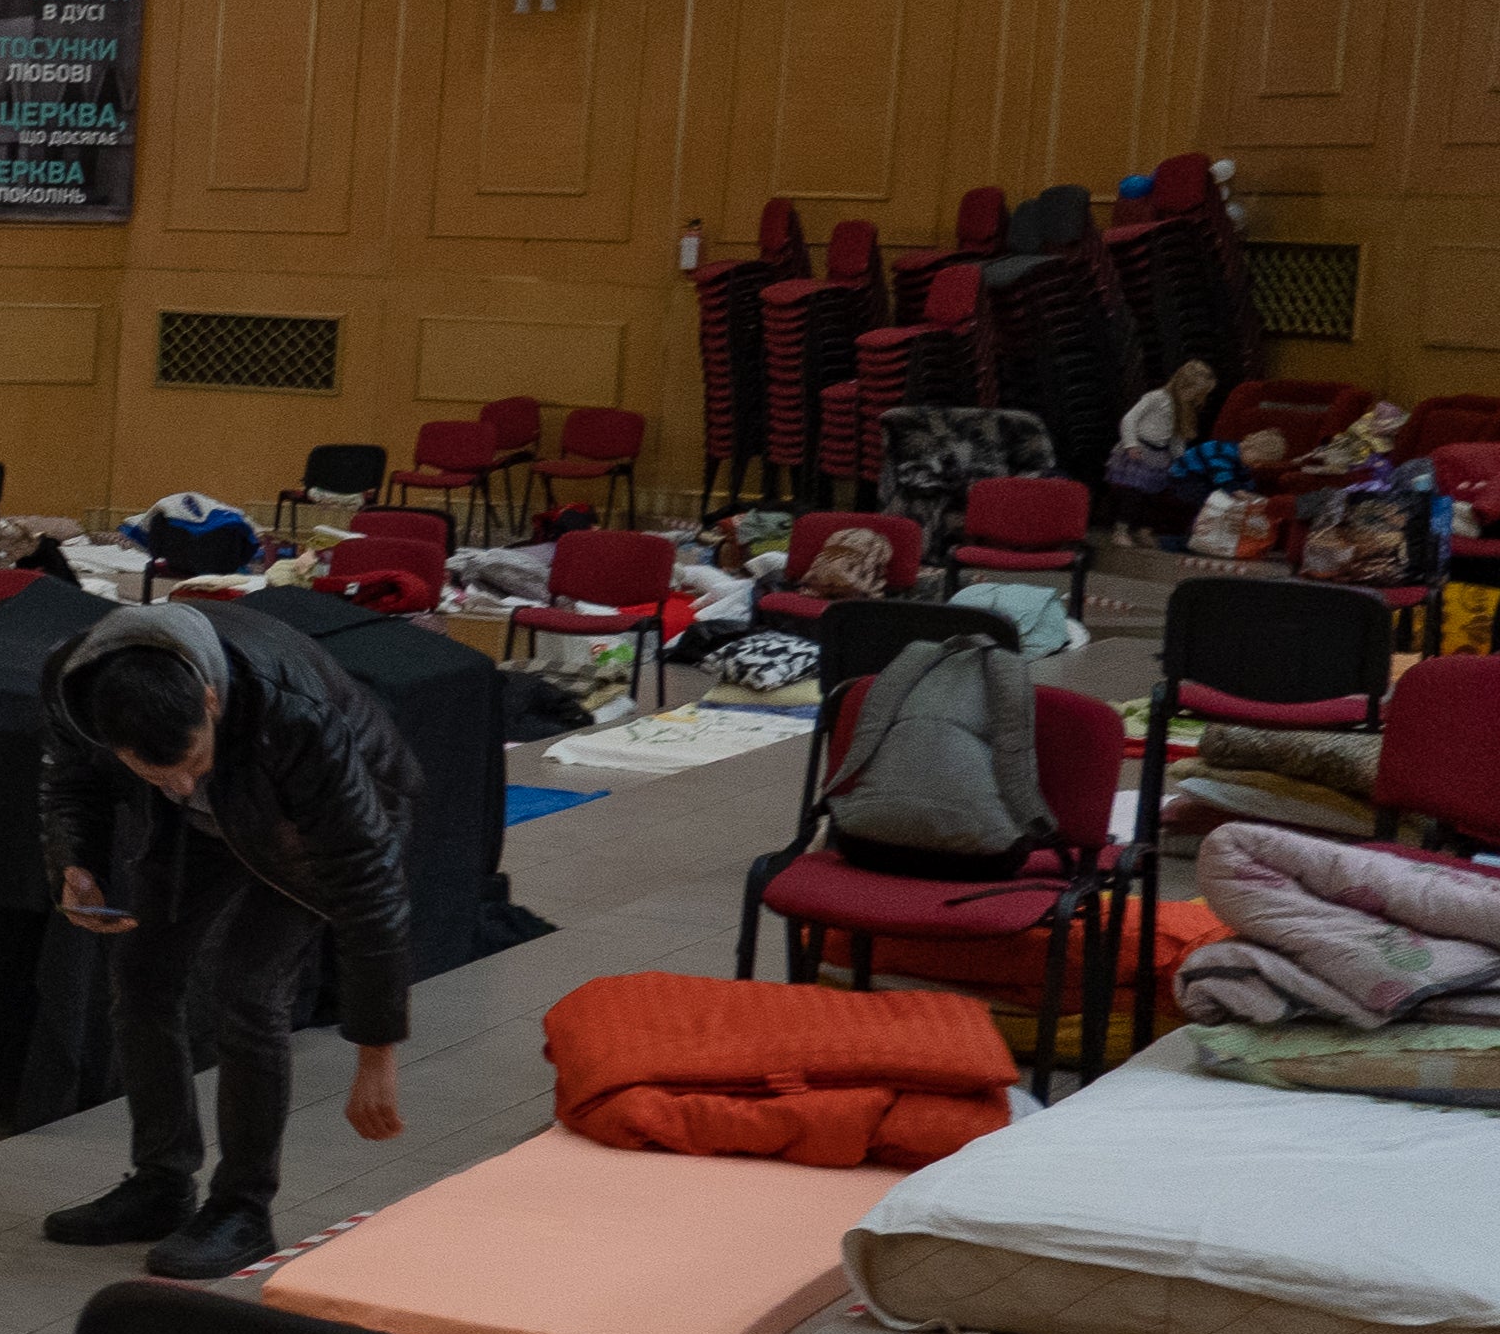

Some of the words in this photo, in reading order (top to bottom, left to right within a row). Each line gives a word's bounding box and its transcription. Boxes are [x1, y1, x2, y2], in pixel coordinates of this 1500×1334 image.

[42, 3, 57, 21] В
[60, 4, 106, 24] ДУСІ
[6, 63, 92, 83] ЛЮБОВІ
